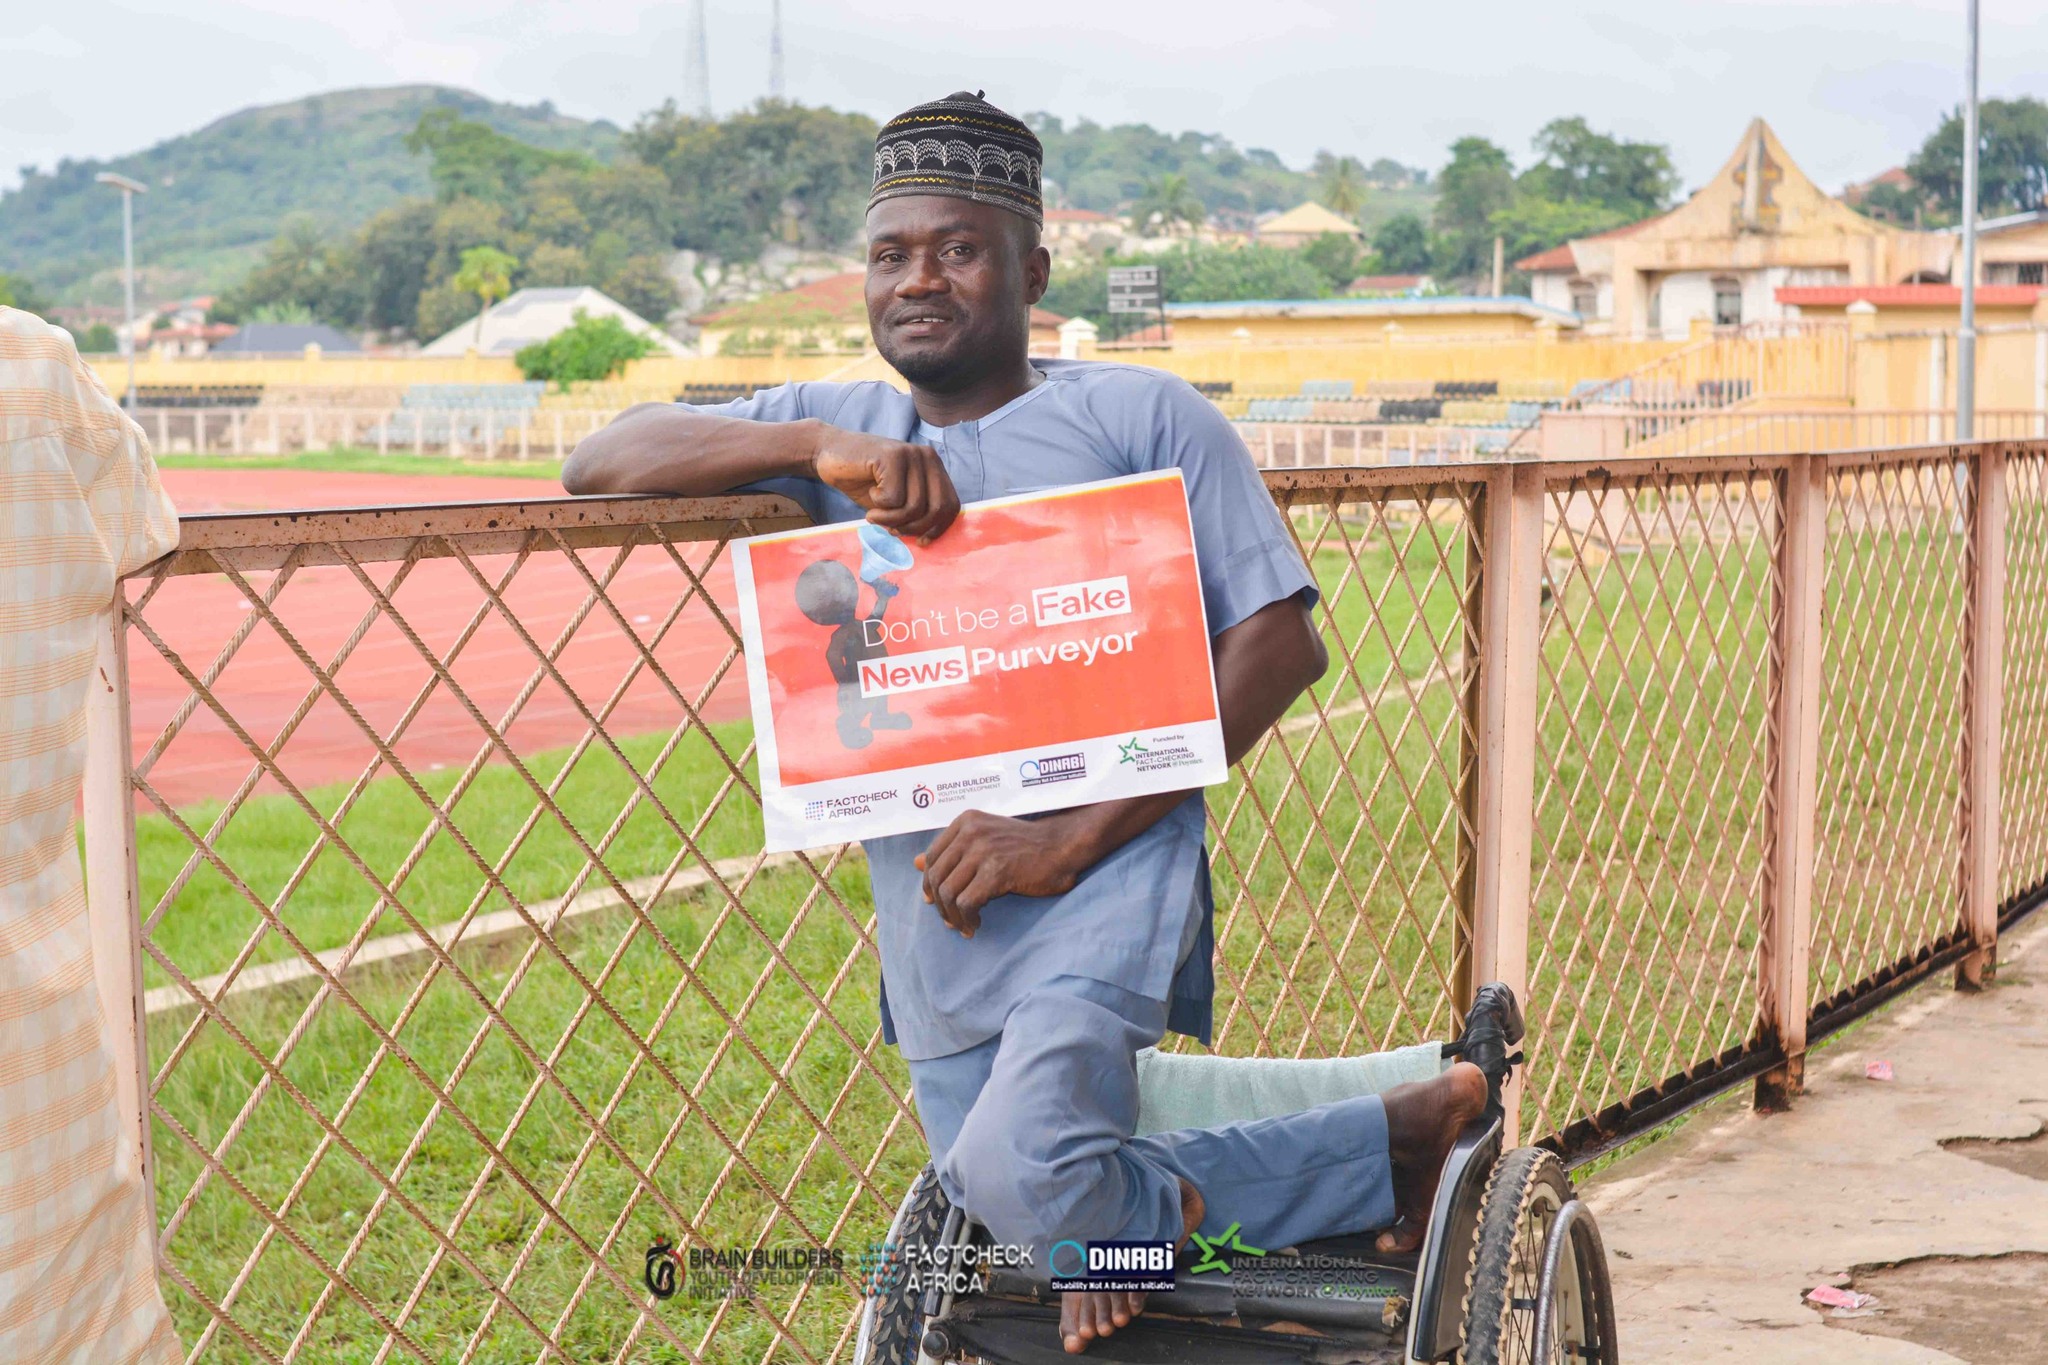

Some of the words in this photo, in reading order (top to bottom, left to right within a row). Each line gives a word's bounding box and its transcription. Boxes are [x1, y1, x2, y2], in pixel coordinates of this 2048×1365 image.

[862, 609, 949, 648] Don't
[955, 606, 1000, 632] be
[1008, 603, 1028, 626] a
[1036, 584, 1126, 621] Fake
[861, 658, 964, 693] News
[971, 629, 1139, 676] Purveyor
[1135, 746, 1189, 759] INTERNATIONAL
[1135, 752, 1195, 765] FACT-CHECKING
[1136, 762, 1172, 772] NETWORK
[936, 781, 961, 791] BRAIN
[962, 775, 1000, 787] BUILDERS
[826, 789, 898, 808] FACTCHECK
[828, 805, 871, 819] AFRICA
